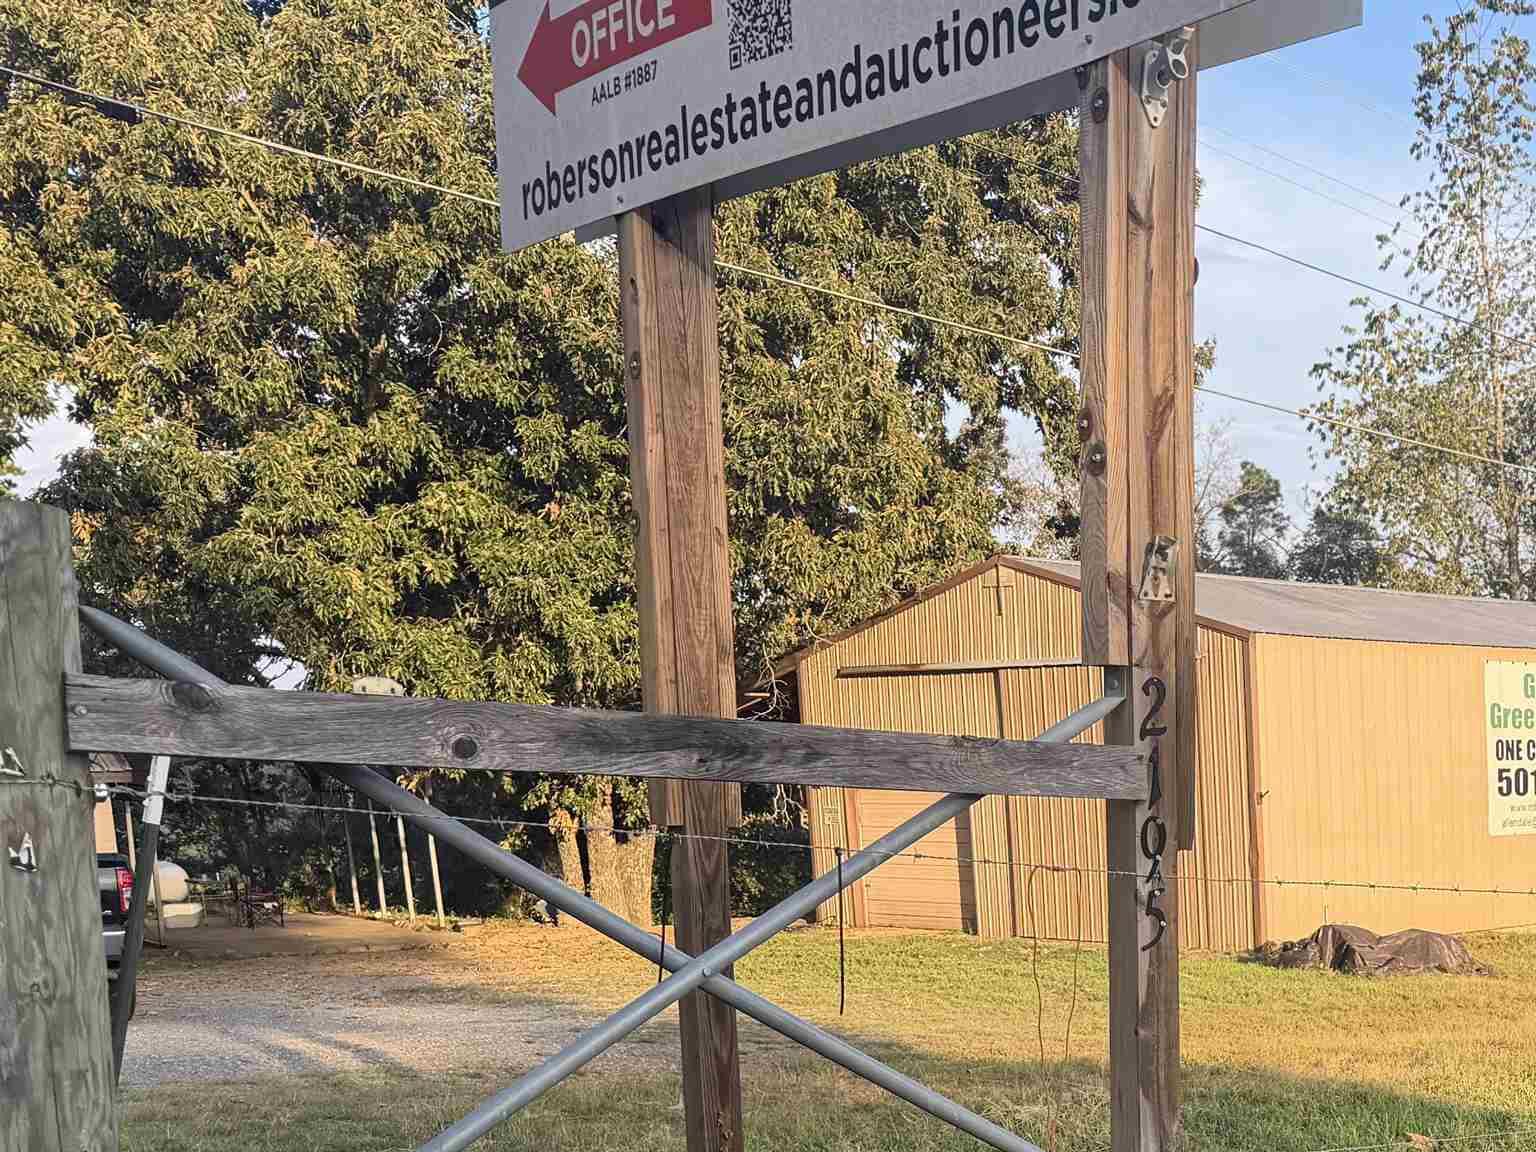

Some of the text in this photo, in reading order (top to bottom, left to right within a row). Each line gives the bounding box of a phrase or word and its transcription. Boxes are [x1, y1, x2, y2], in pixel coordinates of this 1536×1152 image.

[571, 0, 676, 68] OFFICE
[522, 0, 1141, 220] robersonrealestateandauctioneer.
[591, 60, 658, 106] AALB #1887
[1495, 739, 1523, 761] ONE
